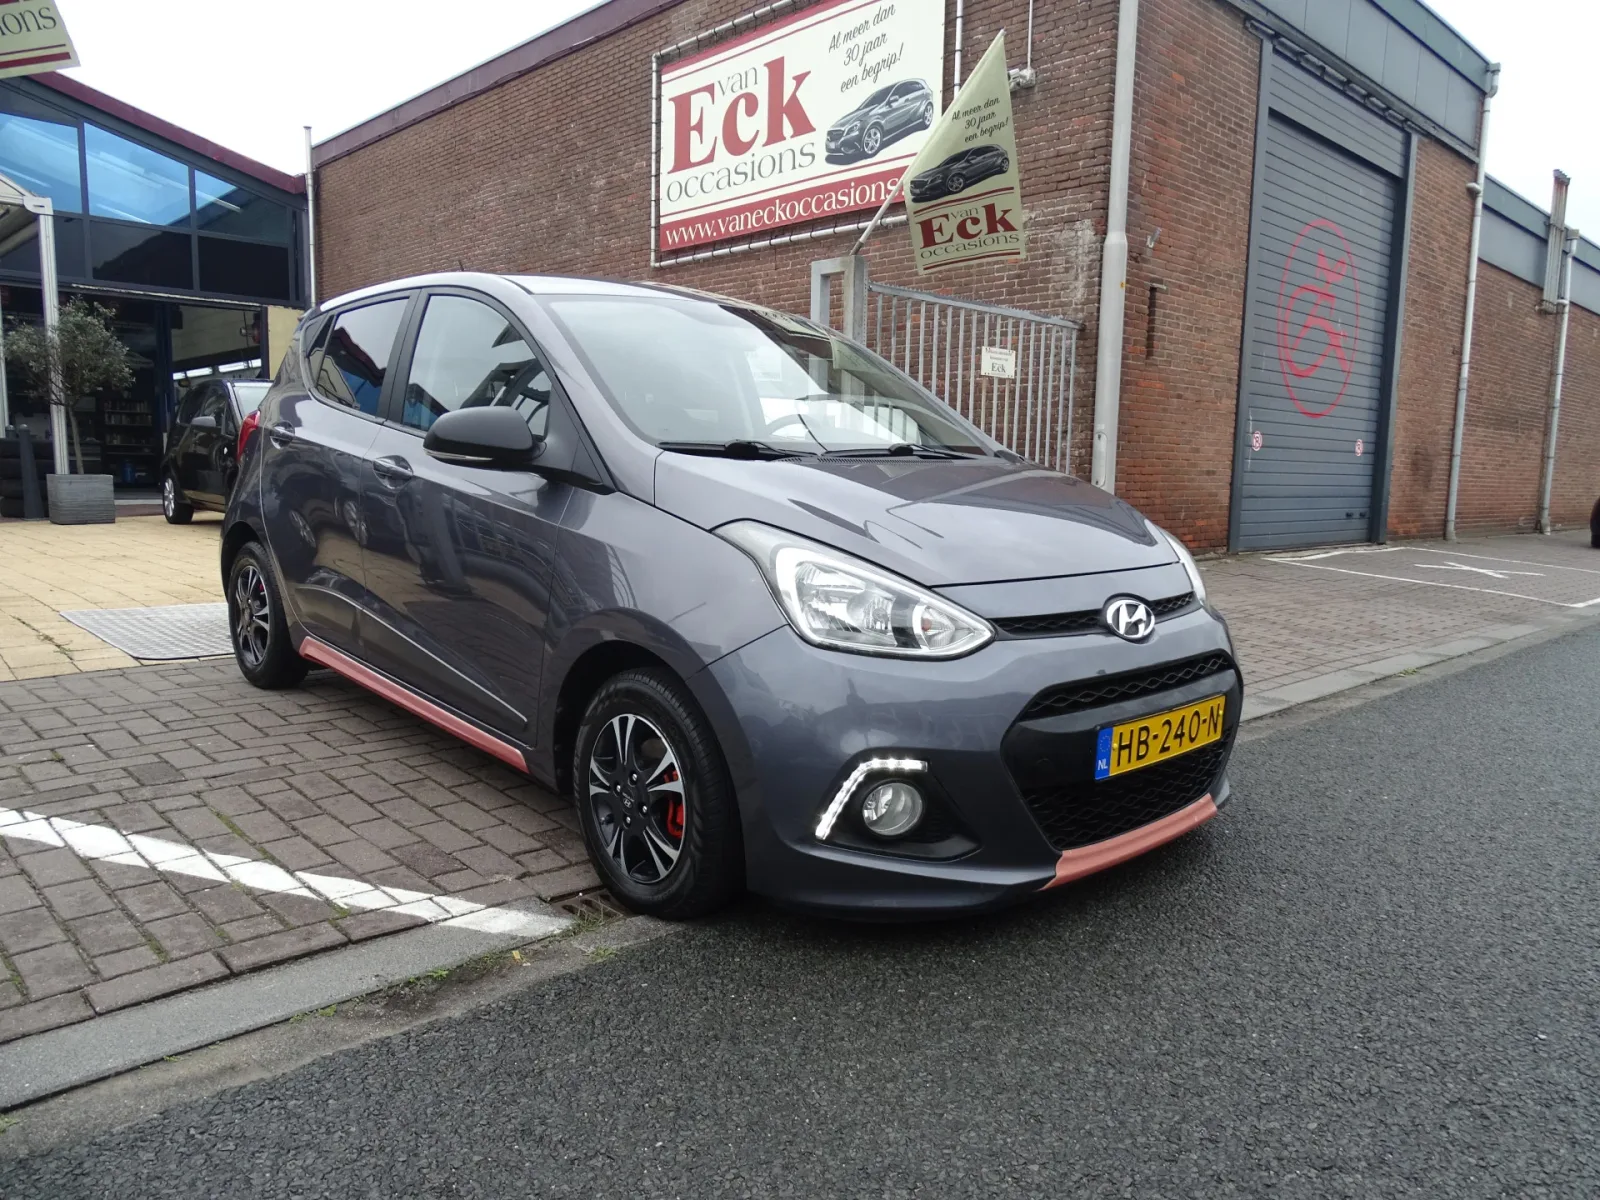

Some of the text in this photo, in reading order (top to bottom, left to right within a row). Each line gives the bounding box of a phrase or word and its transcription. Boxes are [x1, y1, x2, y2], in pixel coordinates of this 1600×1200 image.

[828, 4, 896, 53] Al meer dan
[843, 32, 887, 67] 30 jaar
[717, 66, 758, 97] van
[840, 42, 904, 93] een begrip!
[667, 56, 816, 174] Eck
[951, 97, 1000, 122] Al meer dan
[964, 112, 996, 130] 30 jaar
[964, 116, 1009, 143] een begrip!
[666, 141, 816, 203] occasions
[915, 203, 1018, 249] Eck
[950, 207, 979, 219] van
[920, 233, 1020, 259] occasions
[1117, 703, 1220, 767] HB-240-N
[1097, 758, 1108, 770] NL
